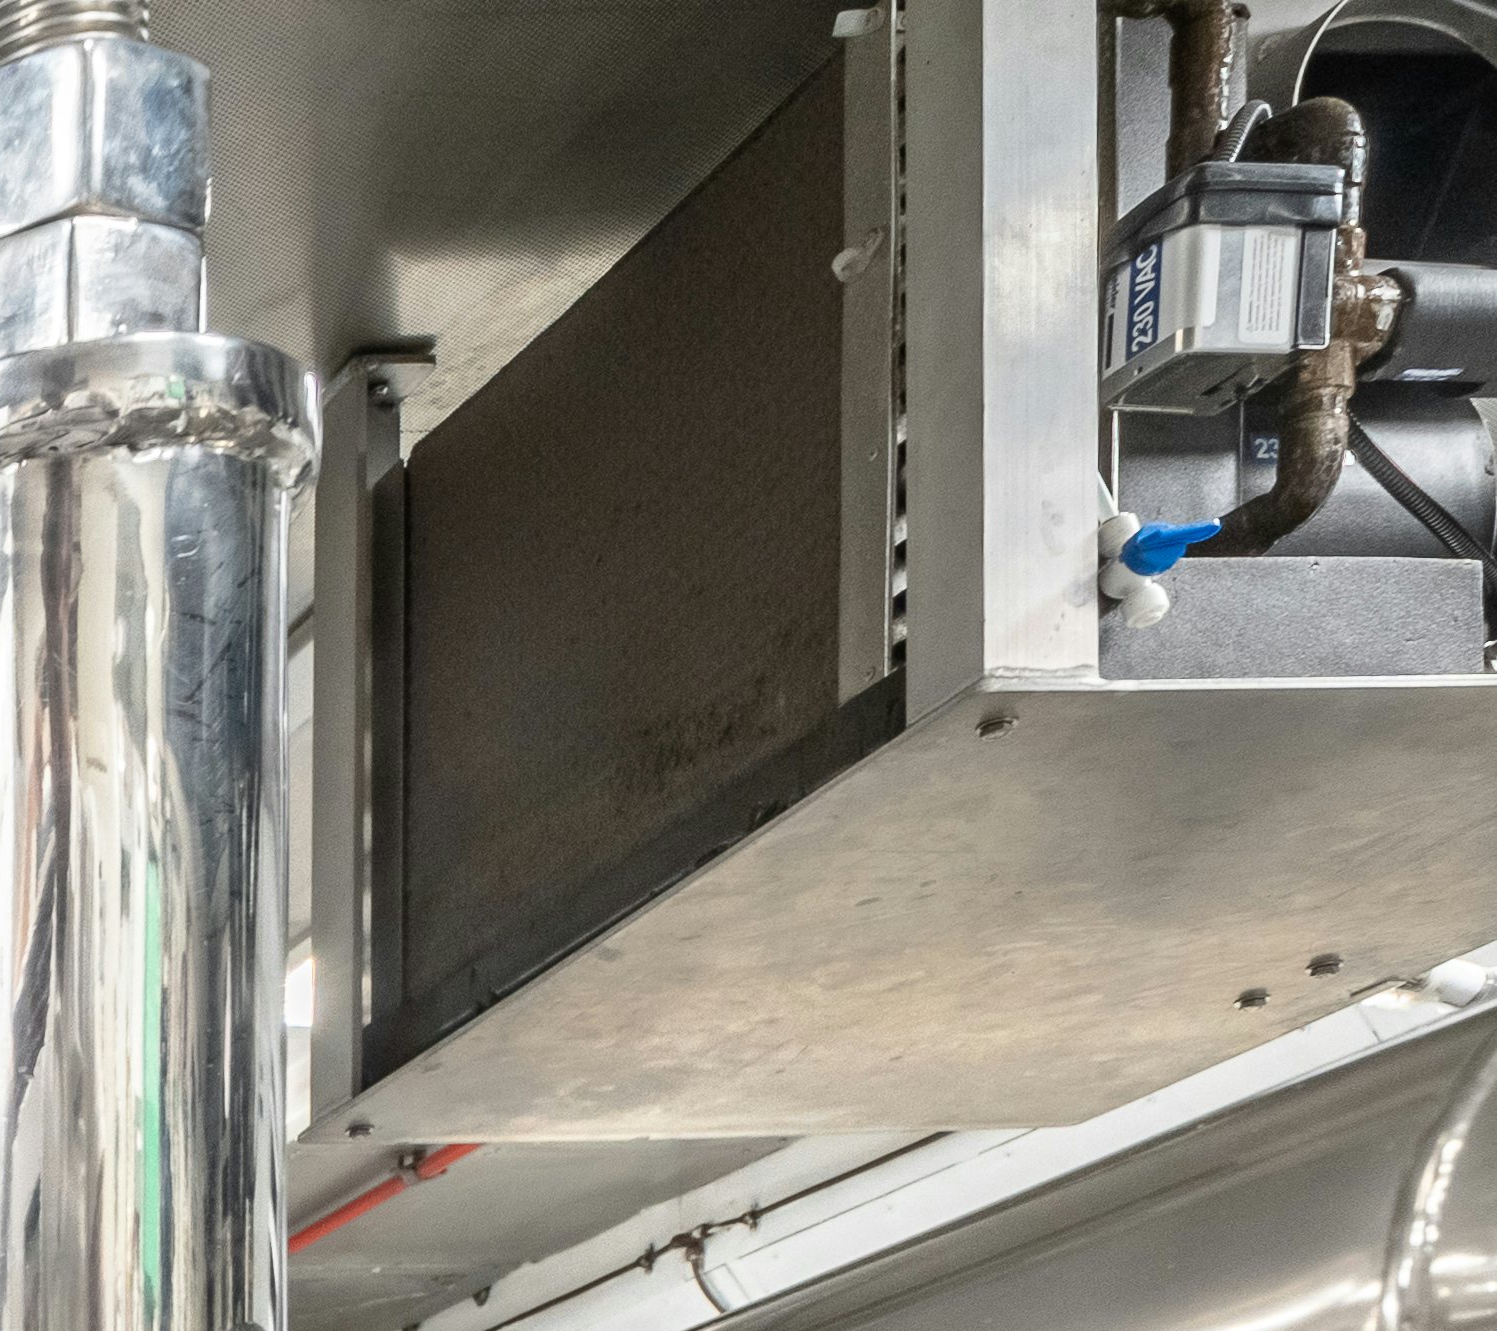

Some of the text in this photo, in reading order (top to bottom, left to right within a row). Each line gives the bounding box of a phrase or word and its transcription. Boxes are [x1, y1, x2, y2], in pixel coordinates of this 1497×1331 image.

[1131, 244, 1159, 353] 230 VAC
[1254, 438, 1279, 459] 23
